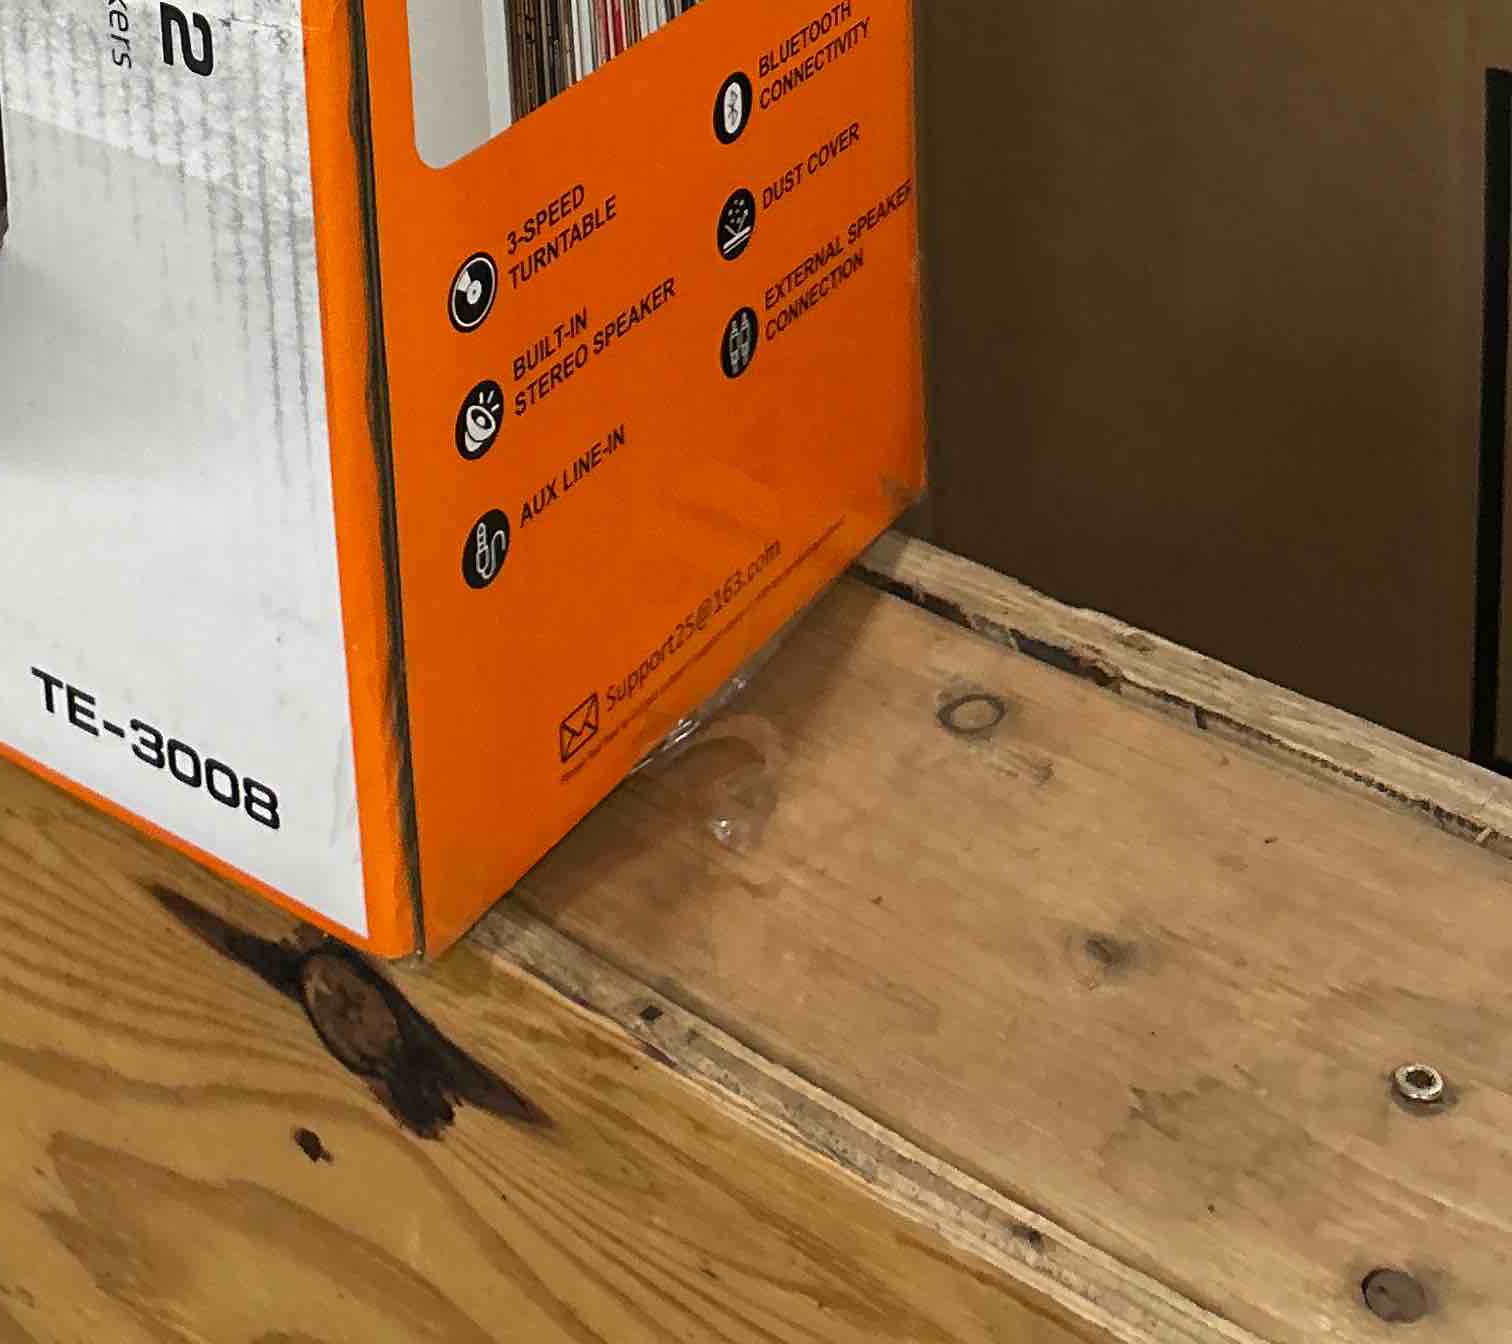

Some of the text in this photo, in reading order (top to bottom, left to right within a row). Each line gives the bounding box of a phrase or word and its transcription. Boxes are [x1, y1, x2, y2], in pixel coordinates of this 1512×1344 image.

[160, 2, 214, 78] 2
[759, 16, 871, 110] CONNECTIVITY
[763, 123, 860, 210] DUST COVER
[506, 184, 585, 255] 3-SPEED
[507, 195, 617, 289] TURNTABLE
[765, 236, 844, 311] EXTERNAL
[765, 247, 864, 342] CONNECTION
[513, 307, 588, 382] BUILT-IN
[515, 277, 676, 416] STEREO SPEAKER
[520, 424, 626, 528] AUX LINE-IN
[31, 665, 280, 829] TE-3008
